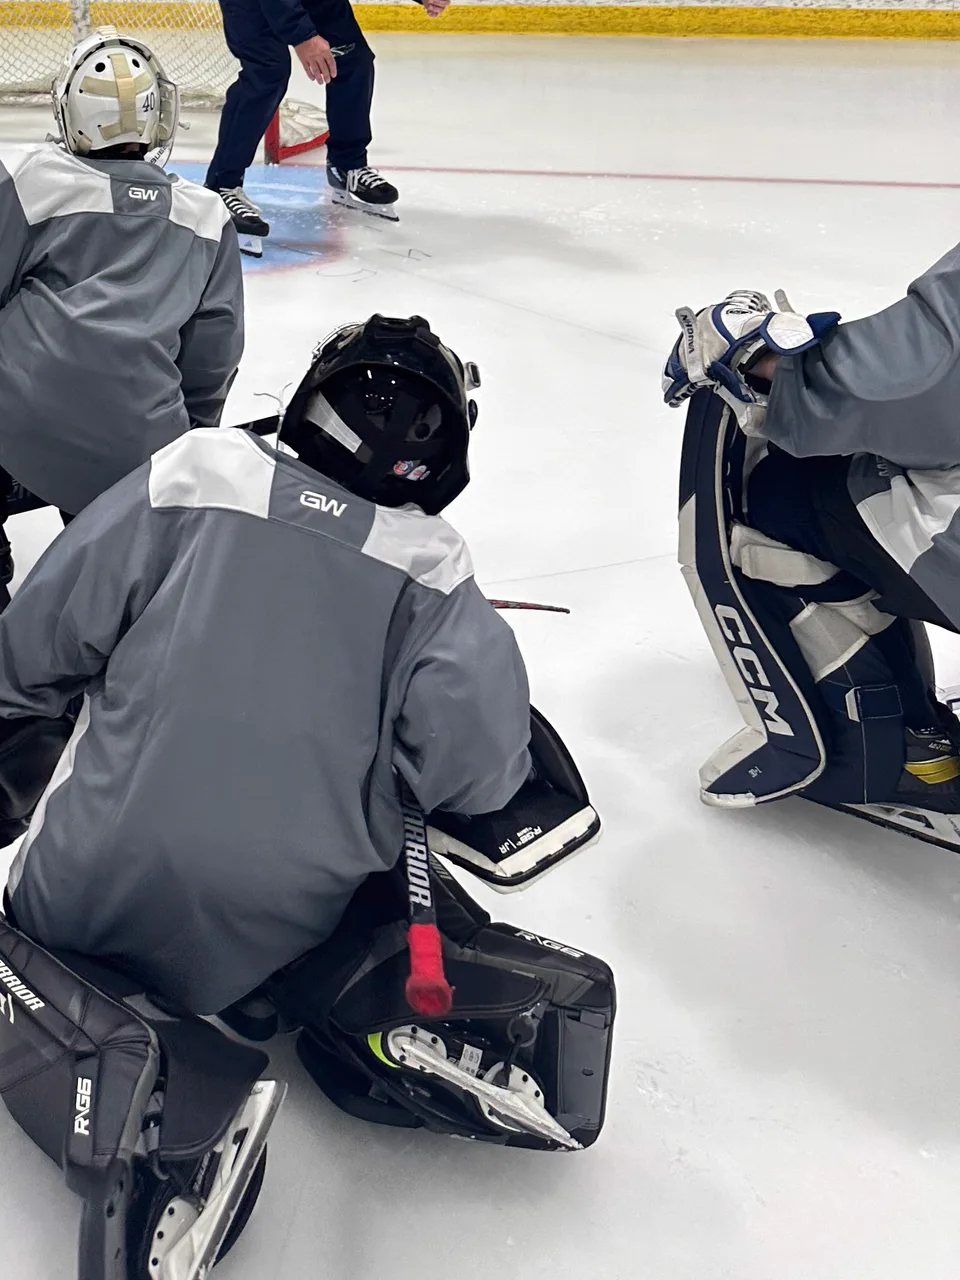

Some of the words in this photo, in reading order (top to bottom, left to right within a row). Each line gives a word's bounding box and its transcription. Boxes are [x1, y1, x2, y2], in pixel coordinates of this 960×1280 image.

[142, 91, 156, 113] 40
[128, 187, 159, 201] GW
[299, 490, 349, 518] GW
[714, 603, 796, 737] CCM
